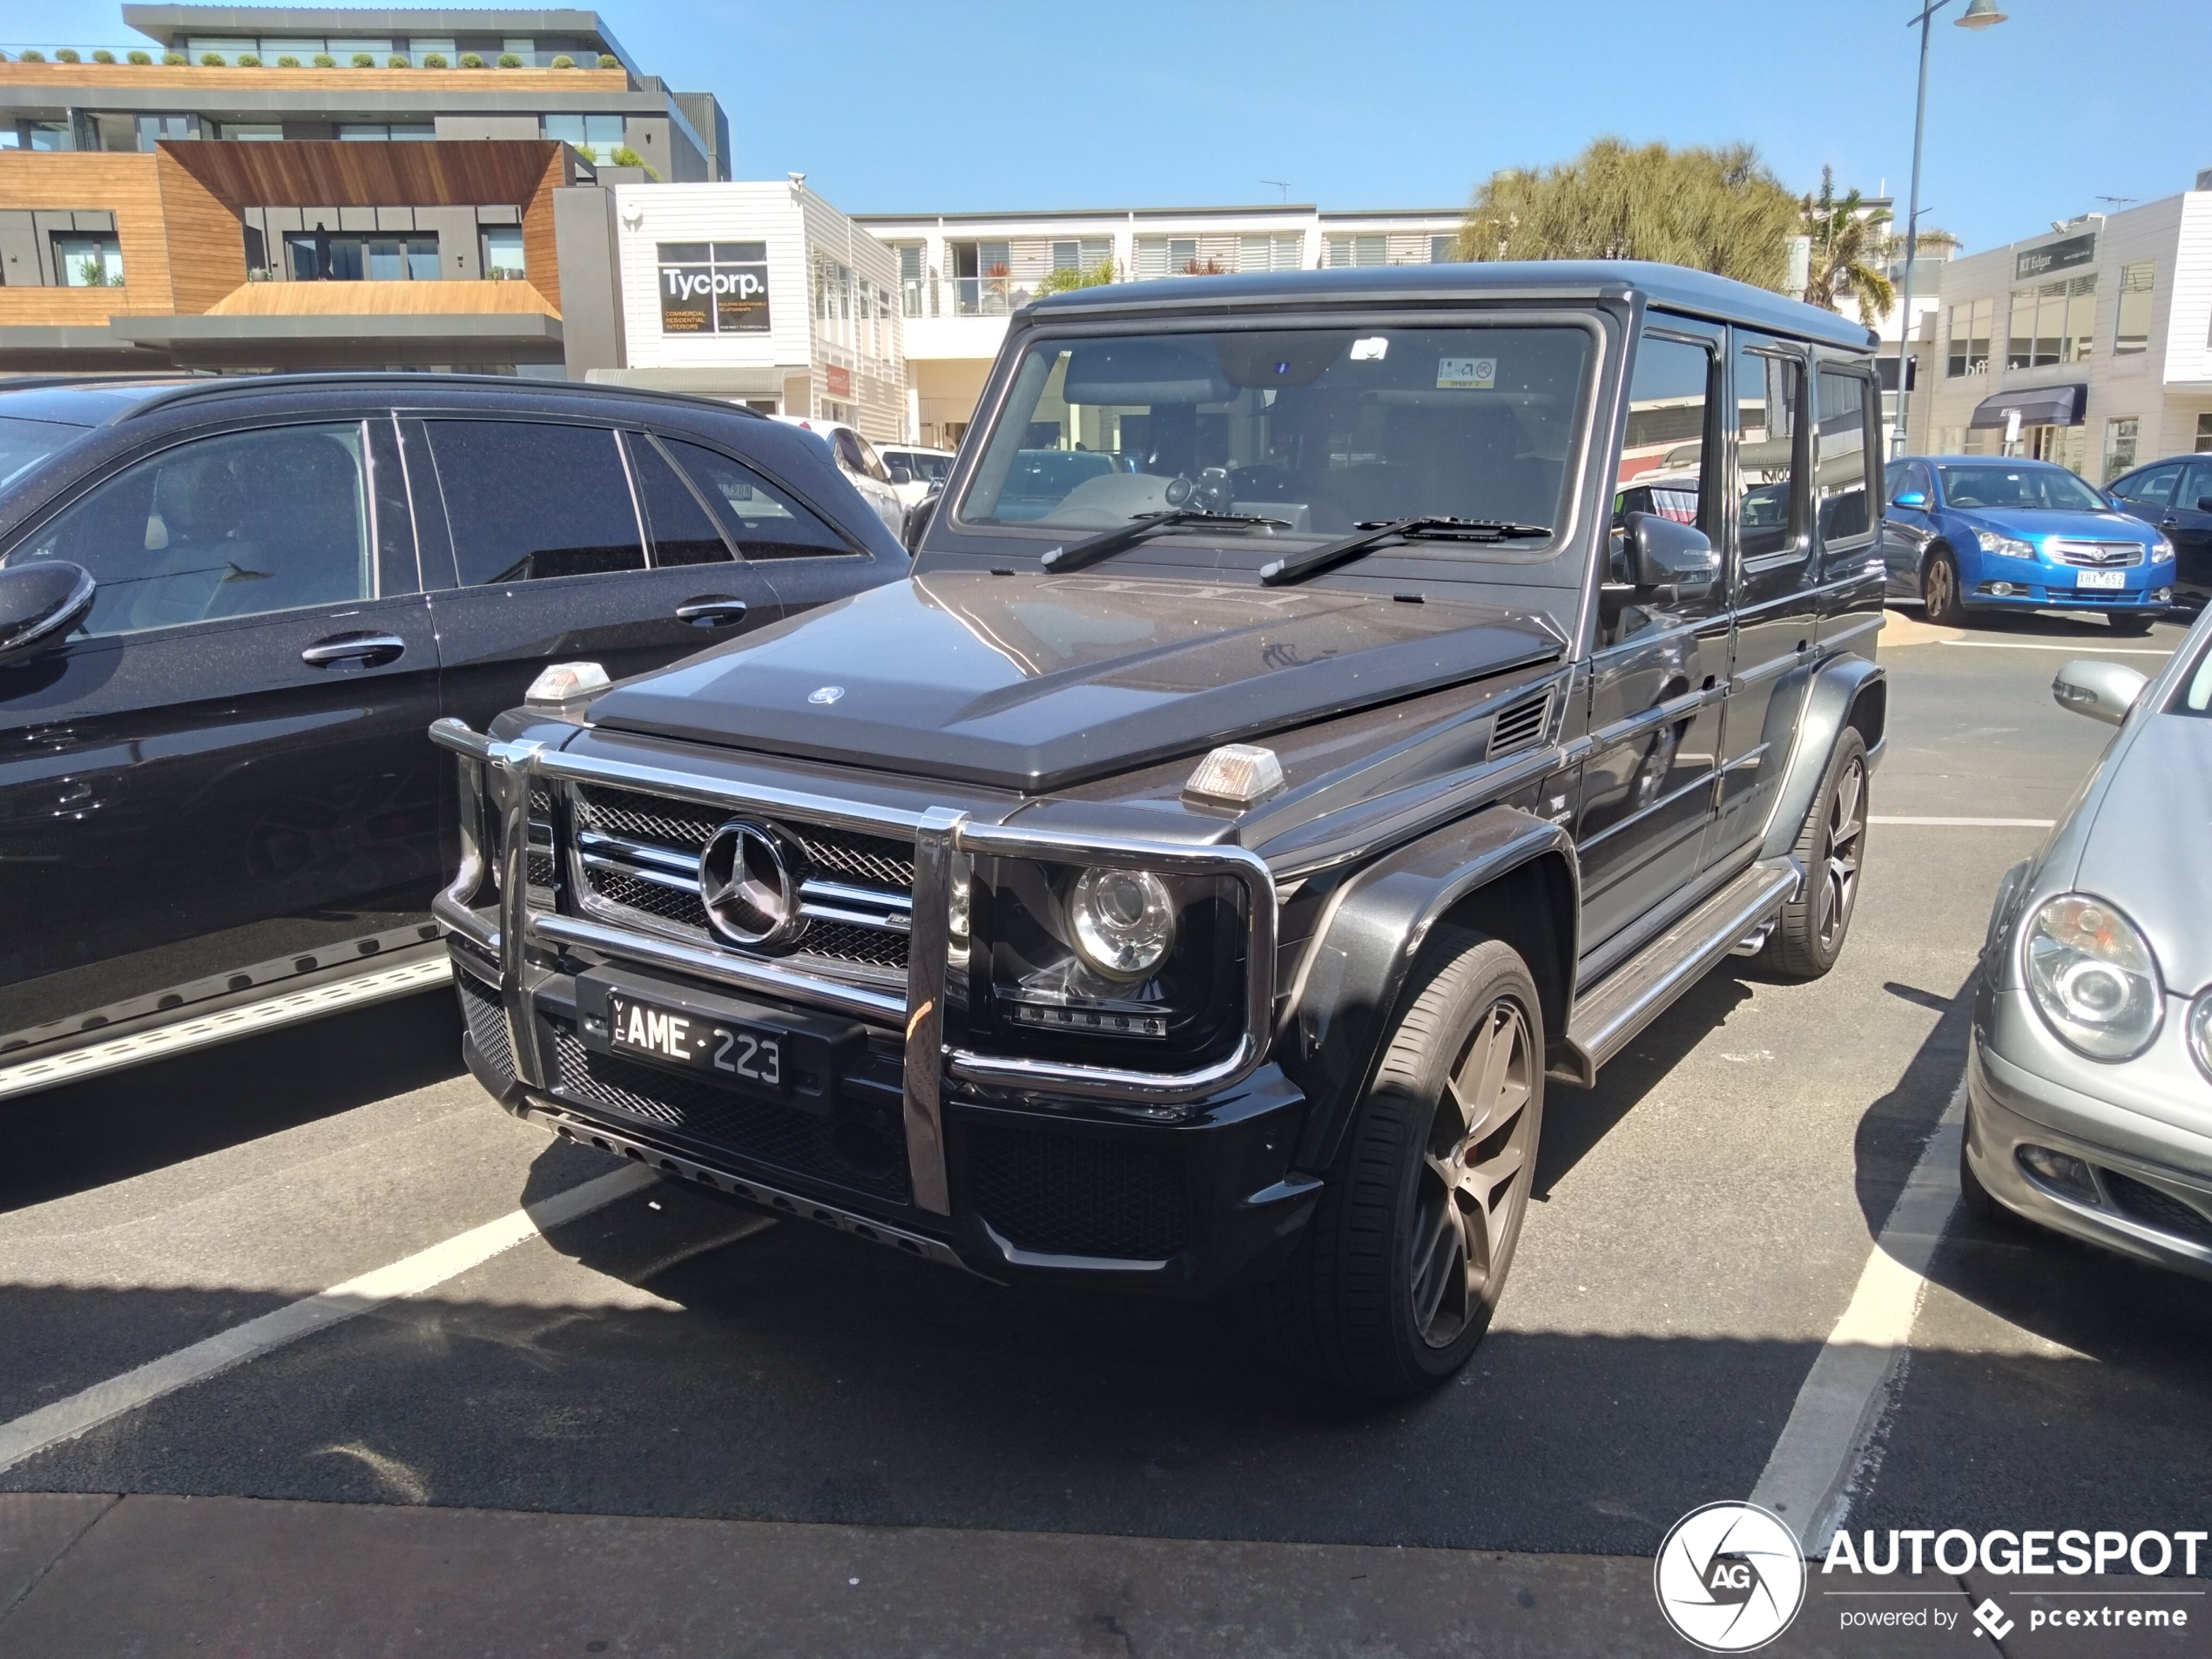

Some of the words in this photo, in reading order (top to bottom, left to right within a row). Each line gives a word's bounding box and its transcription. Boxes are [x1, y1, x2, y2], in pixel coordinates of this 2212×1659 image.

[2020, 258, 2030, 272] RT
[2032, 254, 2052, 271] Edgar
[663, 268, 765, 300] Tycorp.
[2079, 573, 2098, 584] XHX
[2105, 573, 2123, 584] 652
[614, 1000, 625, 1041] VIC
[627, 1005, 691, 1060] AME
[713, 1028, 779, 1084] 223
